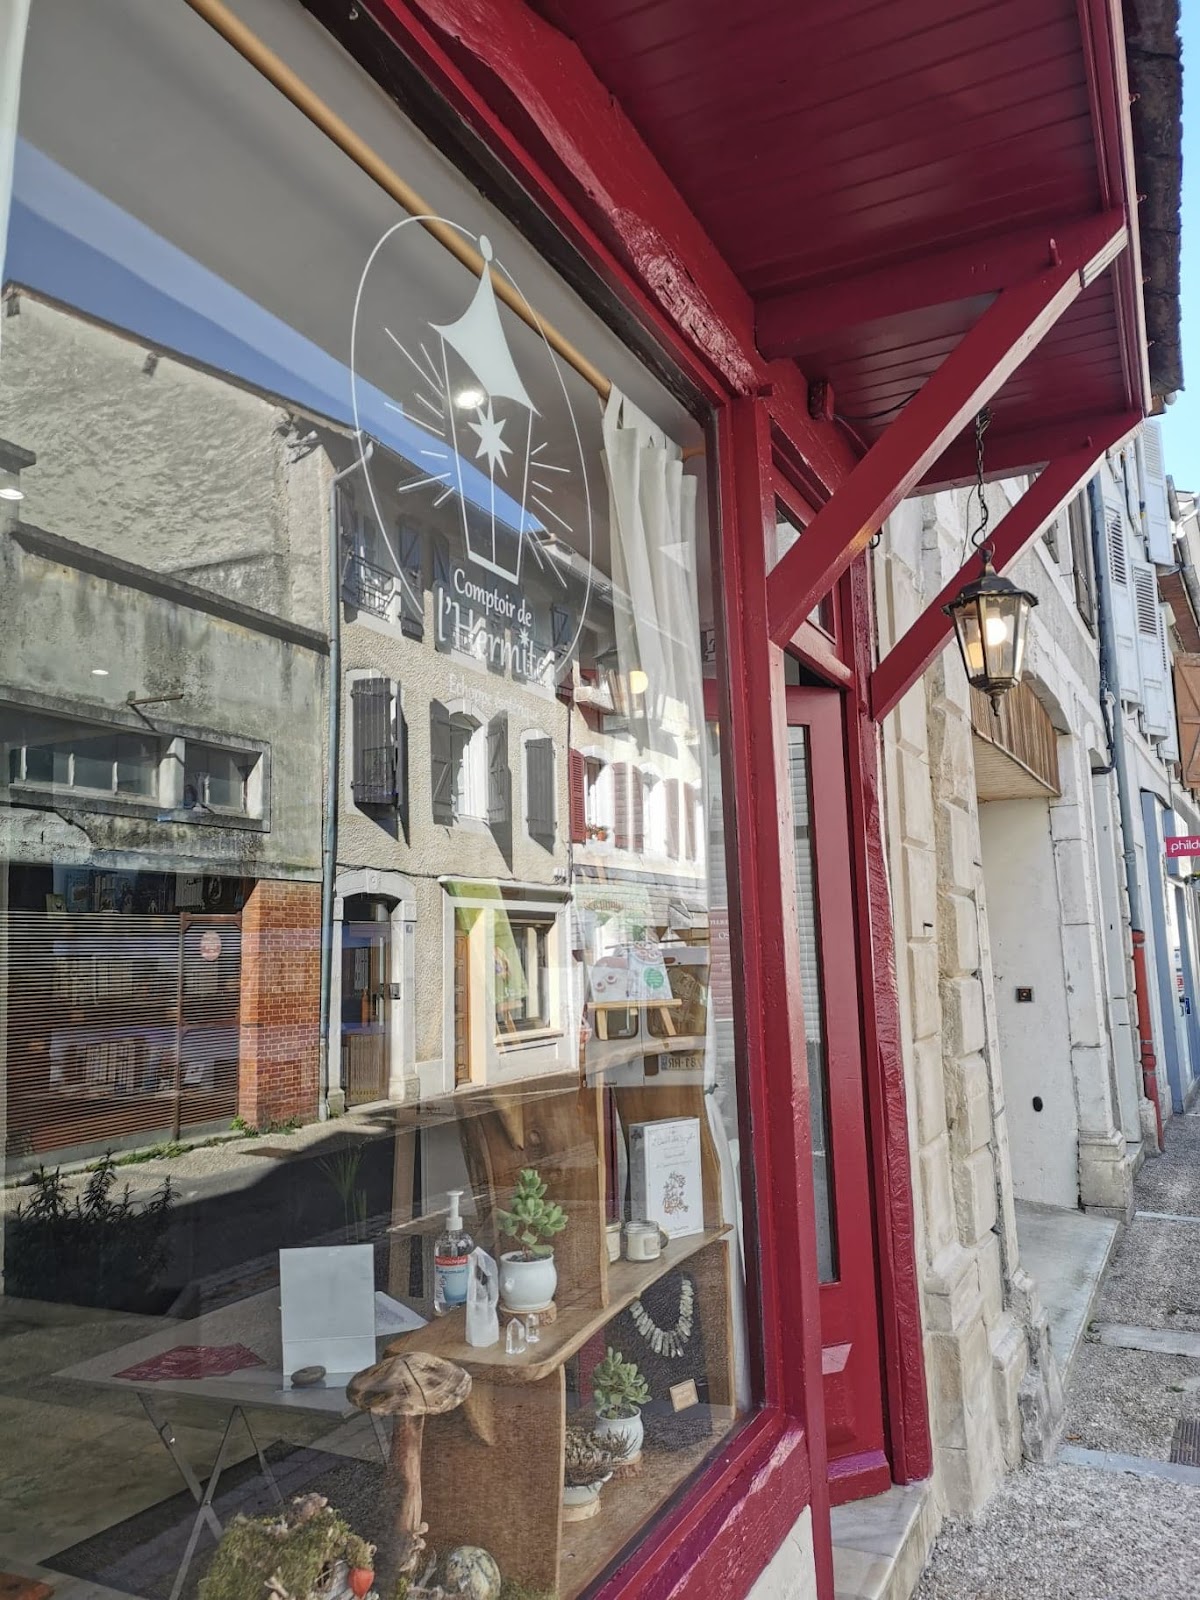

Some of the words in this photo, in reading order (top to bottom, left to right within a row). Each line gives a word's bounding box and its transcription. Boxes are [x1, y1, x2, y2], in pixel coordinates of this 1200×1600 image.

[454, 568, 515, 617] Comptoir
[518, 599, 532, 627] de
[1171, 840, 1200, 853] phild
